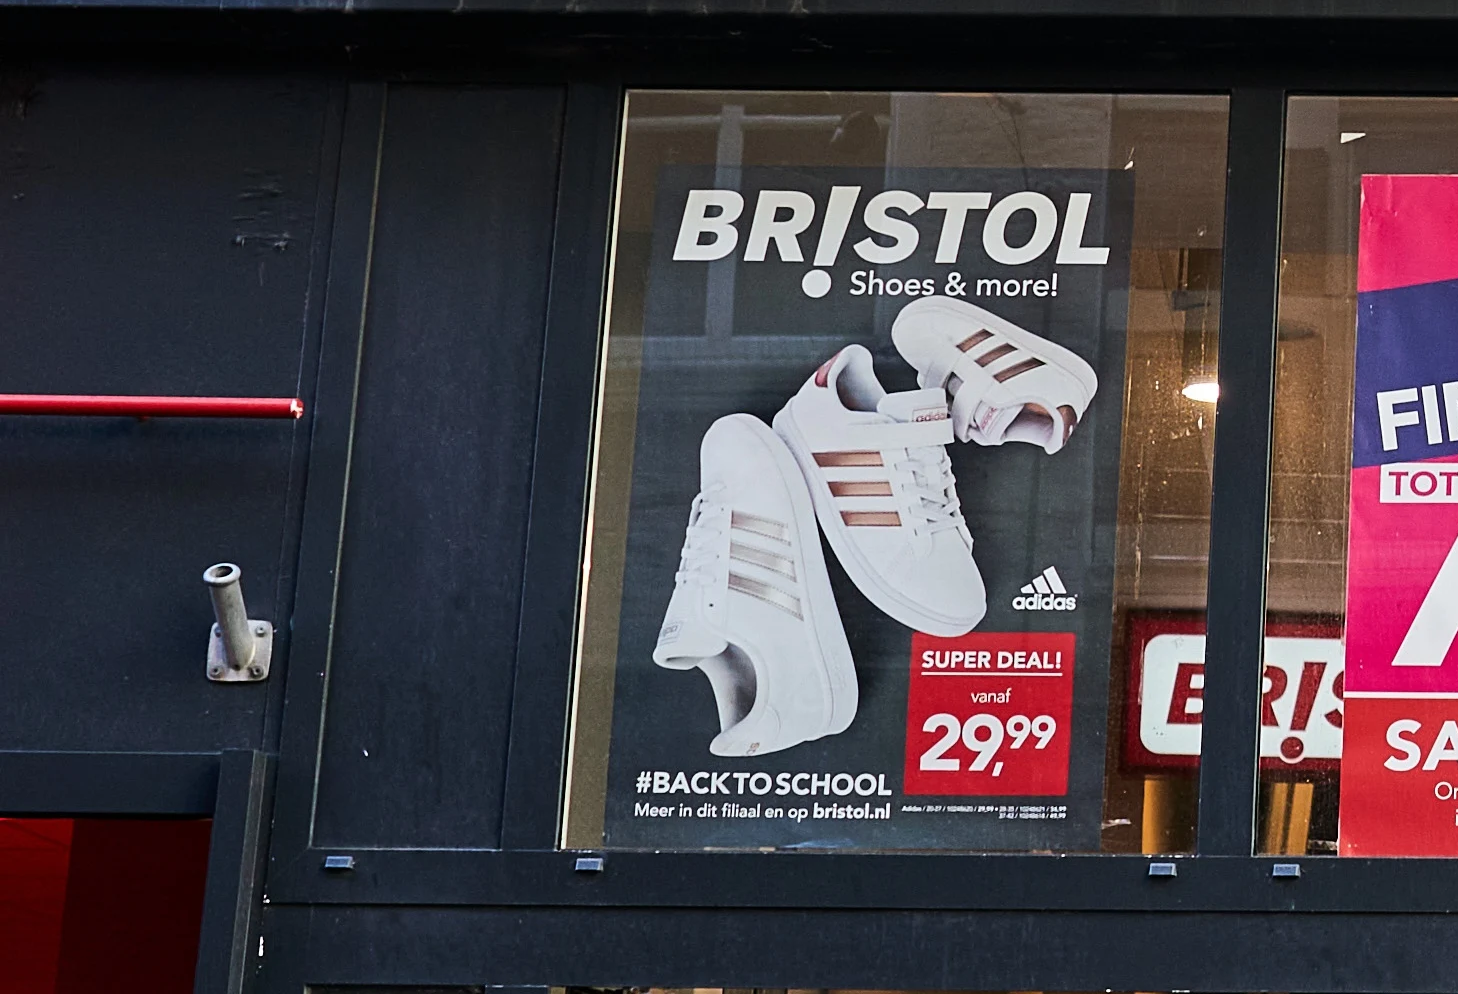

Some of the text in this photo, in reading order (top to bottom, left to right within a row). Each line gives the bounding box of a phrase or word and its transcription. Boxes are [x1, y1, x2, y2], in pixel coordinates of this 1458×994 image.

[673, 186, 1109, 298] BR!STOL
[850, 271, 1057, 296] Shoes & more!
[1389, 471, 1458, 496] TOT
[1012, 593, 1077, 610] adidas
[922, 651, 1061, 668] SUPER DEAL!
[971, 688, 1011, 703] vanaf
[920, 714, 1056, 776] 29,99
[635, 803, 890, 822] Meer in dit filiaal en op bristol.nl
